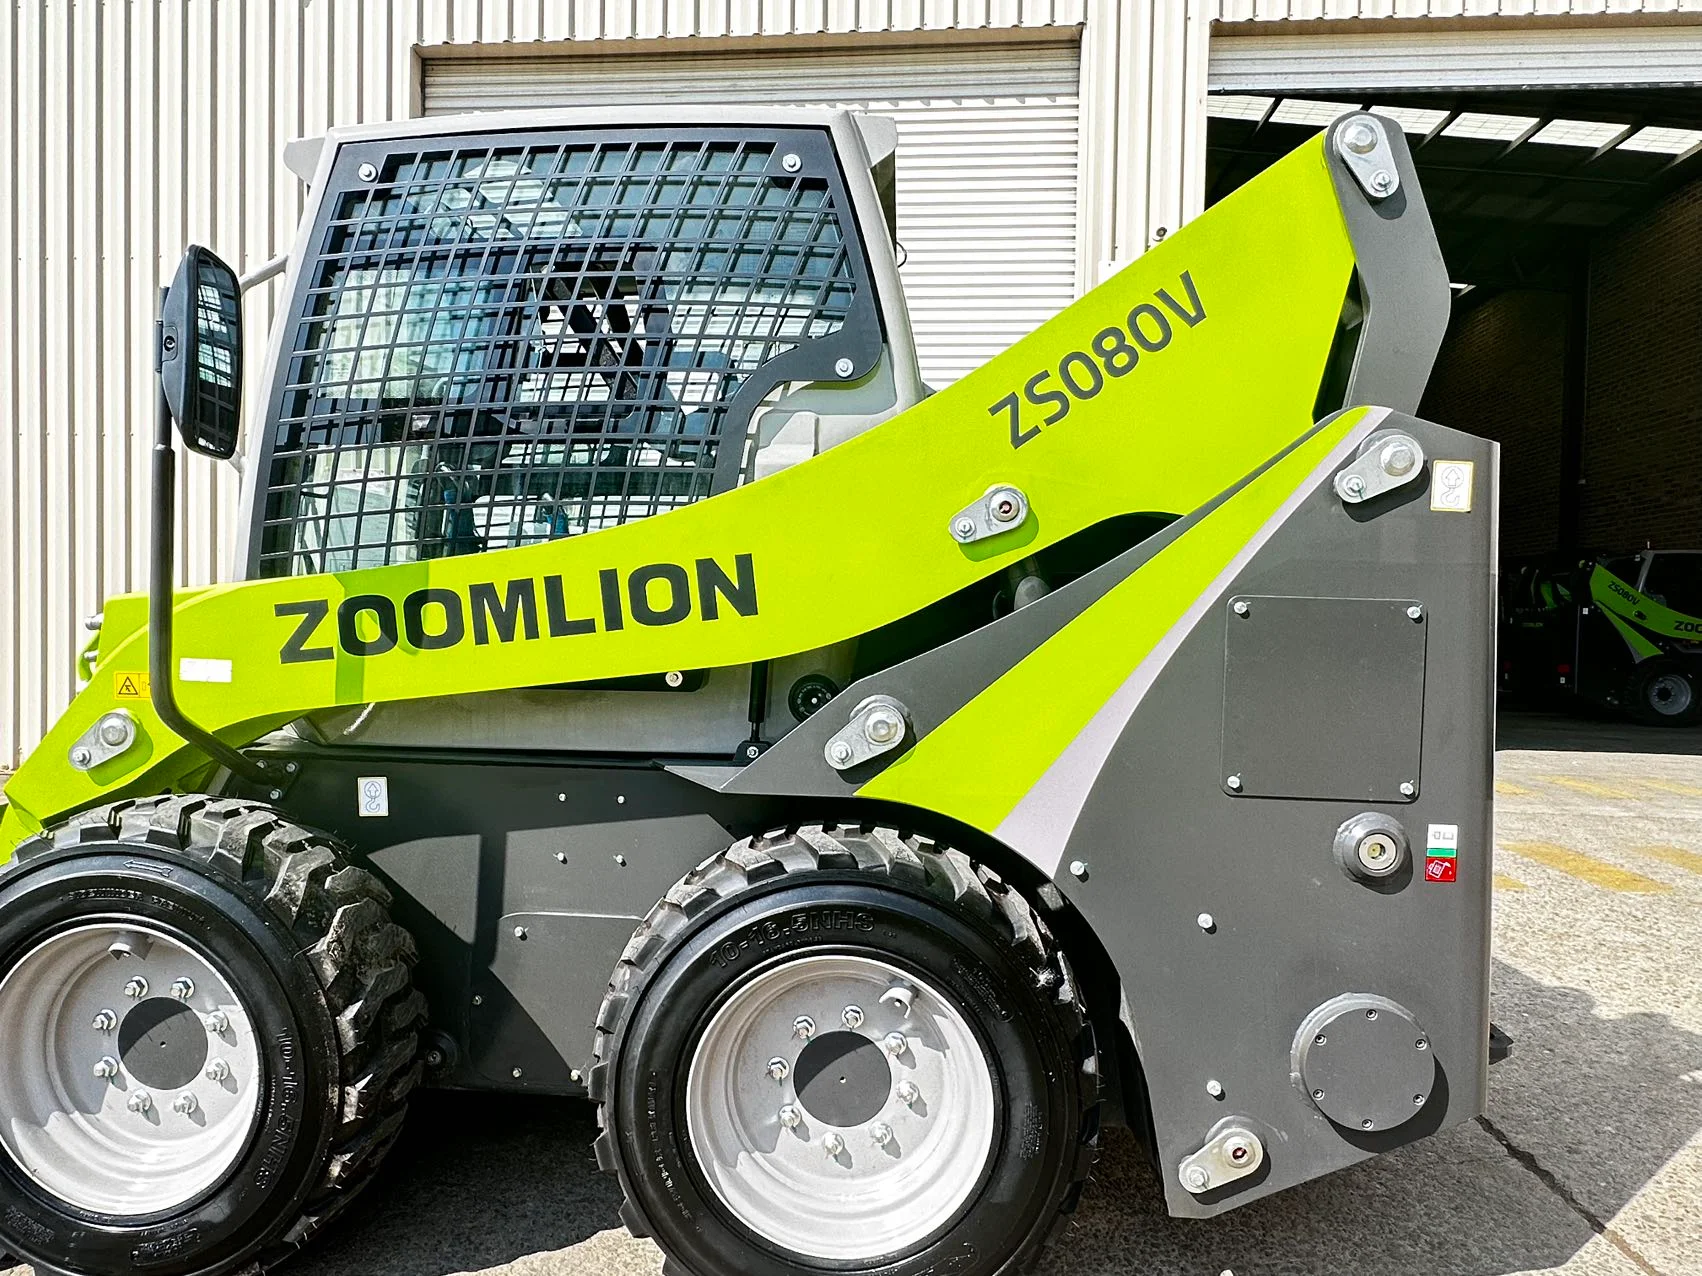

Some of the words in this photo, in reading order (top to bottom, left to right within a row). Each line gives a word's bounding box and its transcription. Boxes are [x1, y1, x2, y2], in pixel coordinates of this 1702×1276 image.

[988, 270, 1207, 450] ZS080V
[274, 553, 758, 664] ZOOMLION
[1607, 581, 1641, 606] ZS080V
[709, 910, 875, 968] 10-16.5NHS
